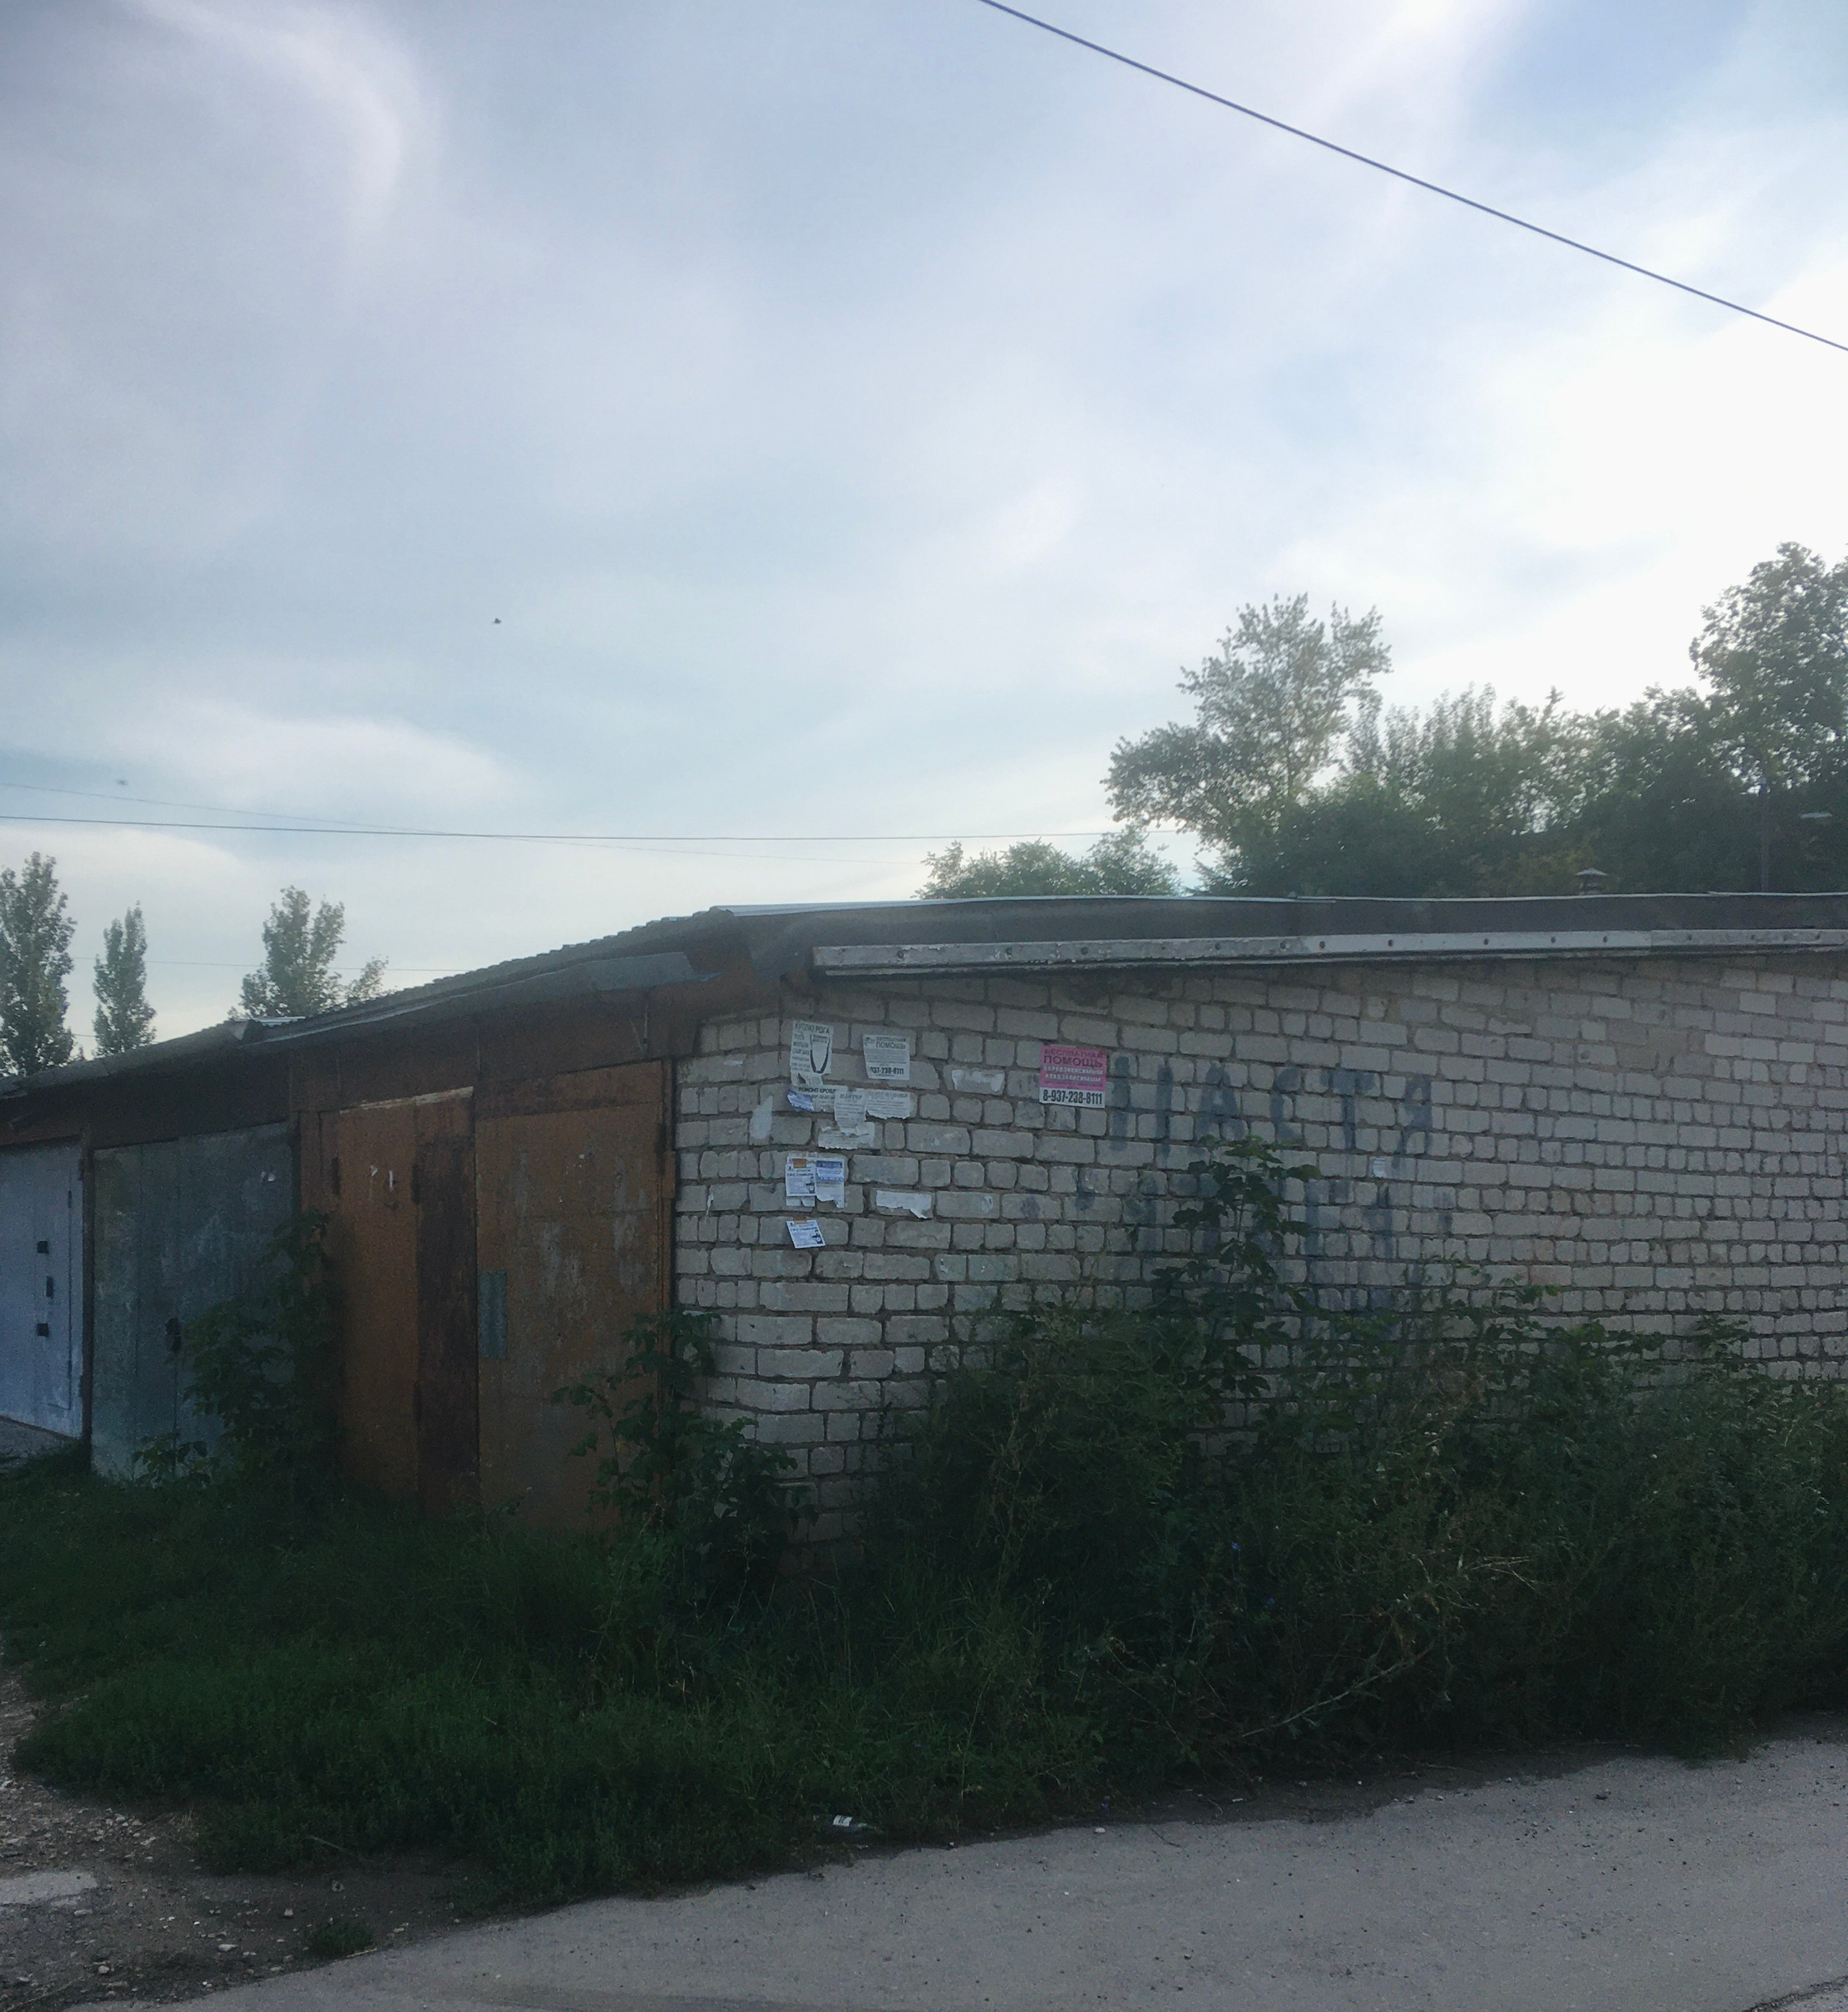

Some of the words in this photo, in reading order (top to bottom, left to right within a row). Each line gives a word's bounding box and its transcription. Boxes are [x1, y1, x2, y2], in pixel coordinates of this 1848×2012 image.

[815, 1025, 830, 1035] РОГА
[1044, 1055, 1102, 1068] ПОМОЩЬ
[1042, 1089, 1102, 1105] 8-937-238-8111
